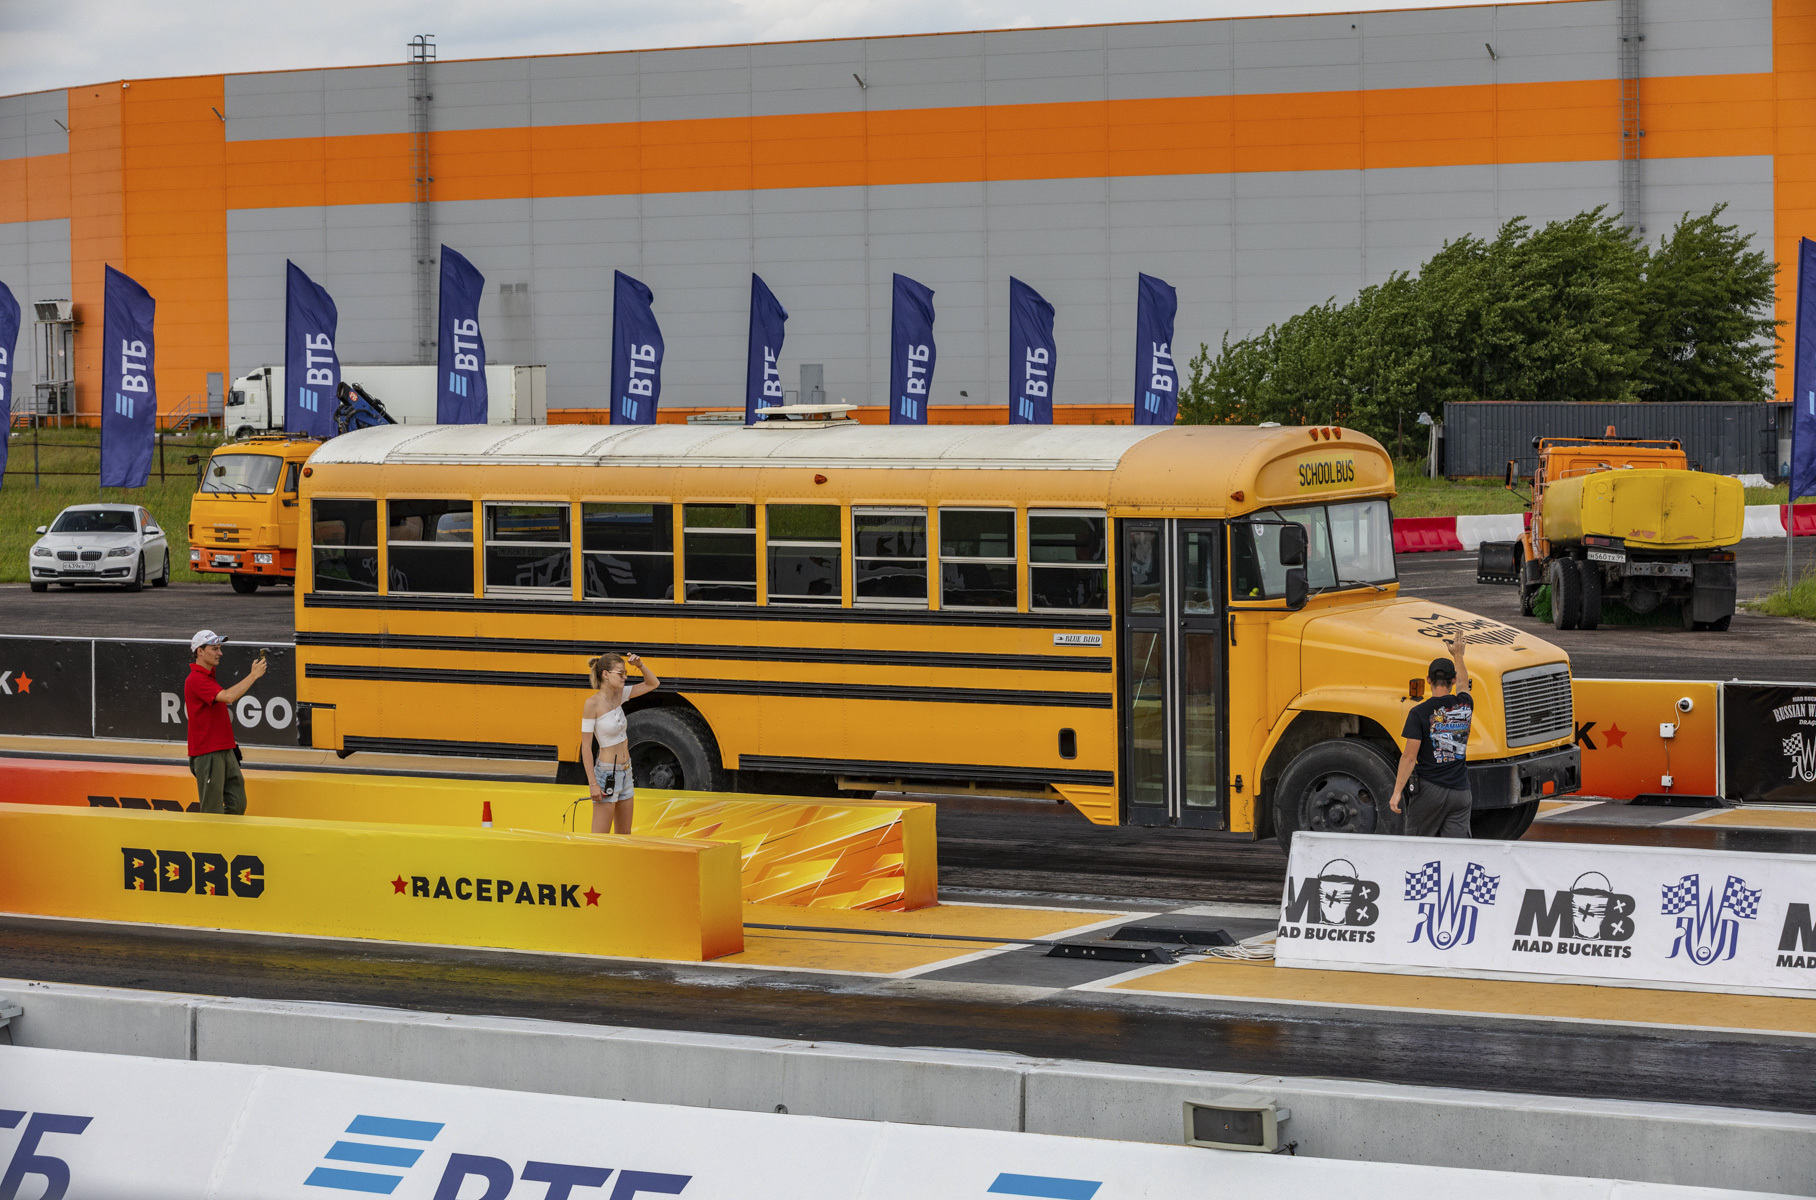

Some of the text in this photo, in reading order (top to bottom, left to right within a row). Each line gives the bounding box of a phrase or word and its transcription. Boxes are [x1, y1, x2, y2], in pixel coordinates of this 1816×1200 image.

[306, 333, 333, 386] ВТБ
[453, 318, 479, 372] ВТБ
[122, 339, 149, 393] ВТБ
[629, 343, 656, 397] ВТБ
[907, 344, 930, 395] ВТБ
[1026, 347, 1049, 397] ВТБ
[1299, 459, 1355, 487] SCHOOL BUS
[1064, 635, 1101, 643] BLUE BIRD
[1772, 703, 1806, 722] RUSSIAN
[121, 847, 265, 899] RDRC
[411, 876, 581, 908] RACEPARK
[1304, 928, 1376, 944] BUCKETS
[1511, 939, 1632, 959] MAD BUCKETS
[1775, 954, 1816, 969] MAD
